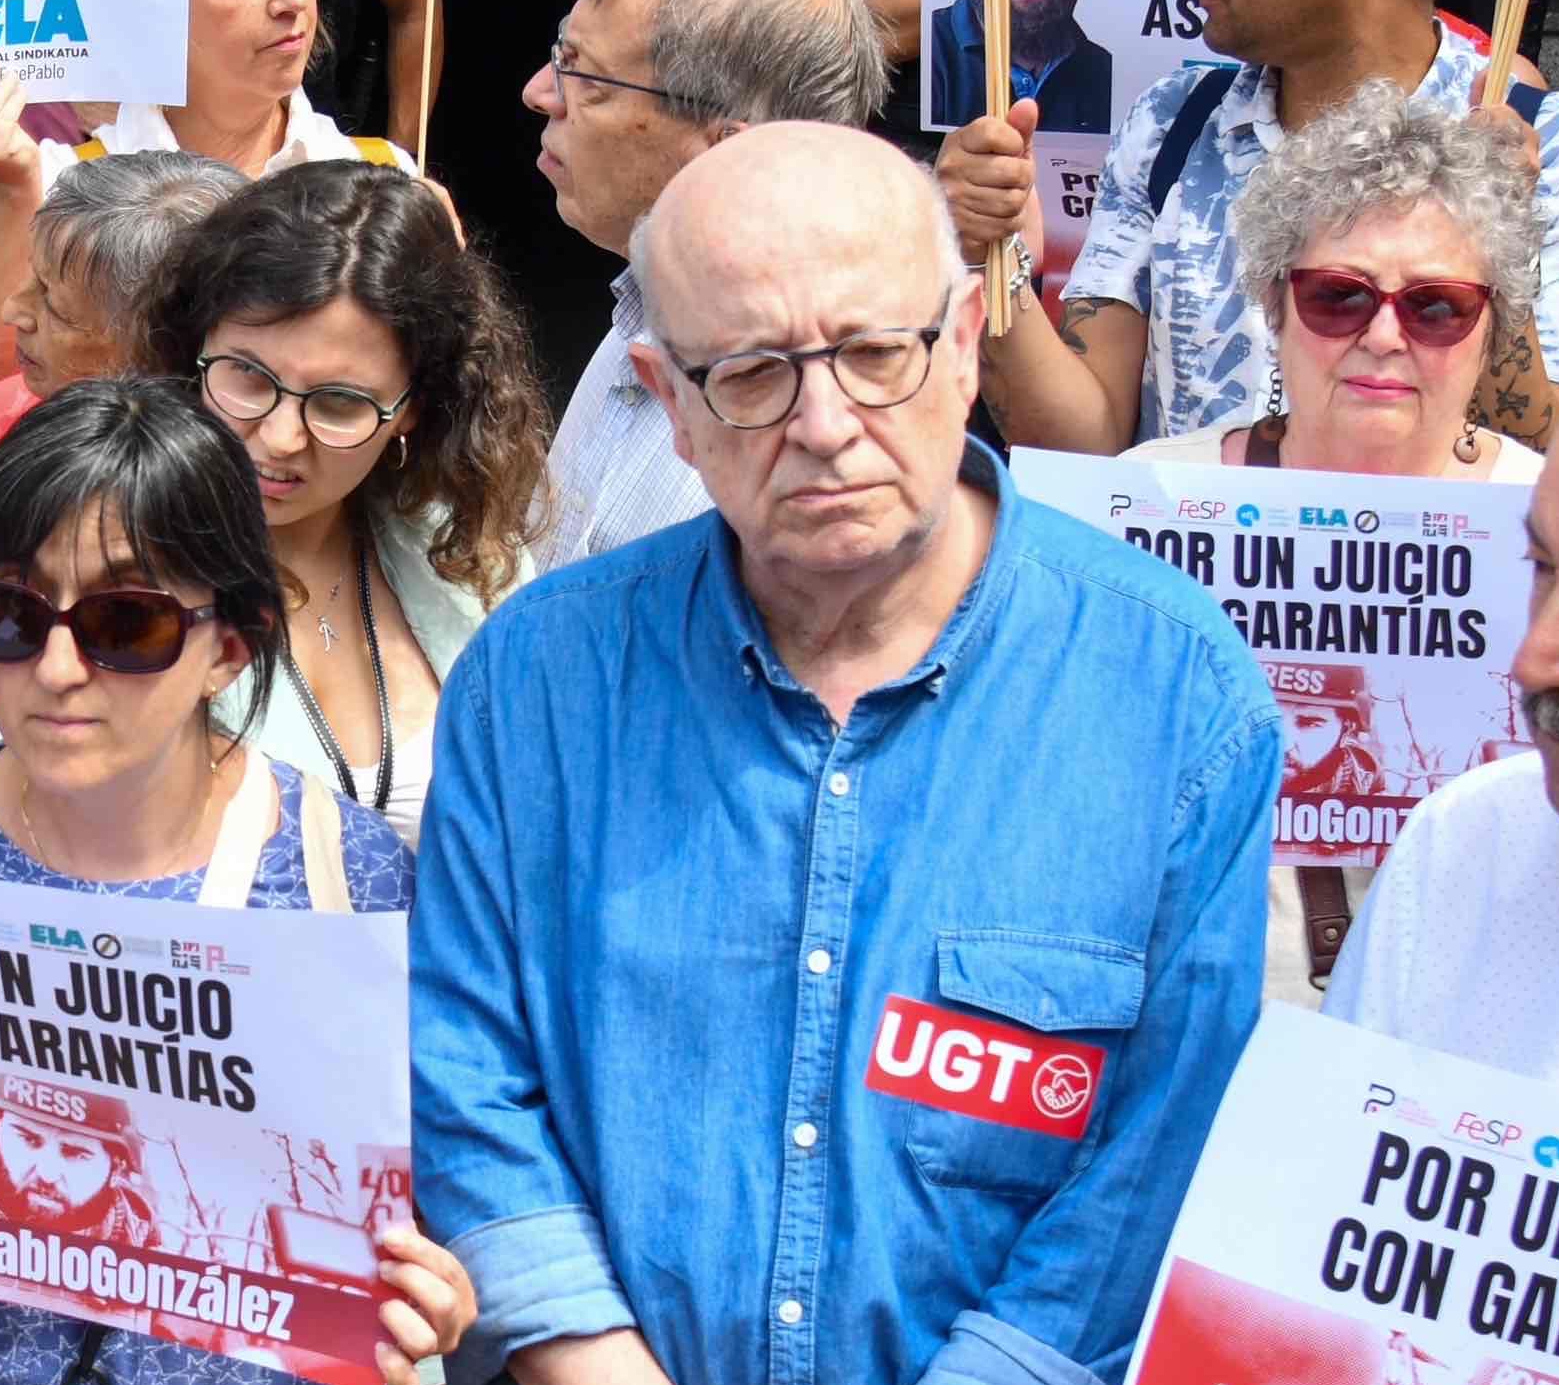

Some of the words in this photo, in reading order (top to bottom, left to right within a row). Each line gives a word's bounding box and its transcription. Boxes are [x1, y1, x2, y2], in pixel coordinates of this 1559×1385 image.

[13, 47, 90, 61] SINDIKATUA
[1299, 506, 1349, 527] ELA
[1233, 533, 1295, 590] UN
[1314, 540, 1473, 599] JUICIO
[29, 923, 87, 950] ELA
[54, 959, 234, 1042] JUICIO
[875, 1011, 1034, 1104] UGT
[3, 1077, 88, 1124] PRESS
[1453, 1111, 1523, 1147] FeSP
[1361, 1130, 1497, 1242] POR
[1321, 1215, 1451, 1322] CON
